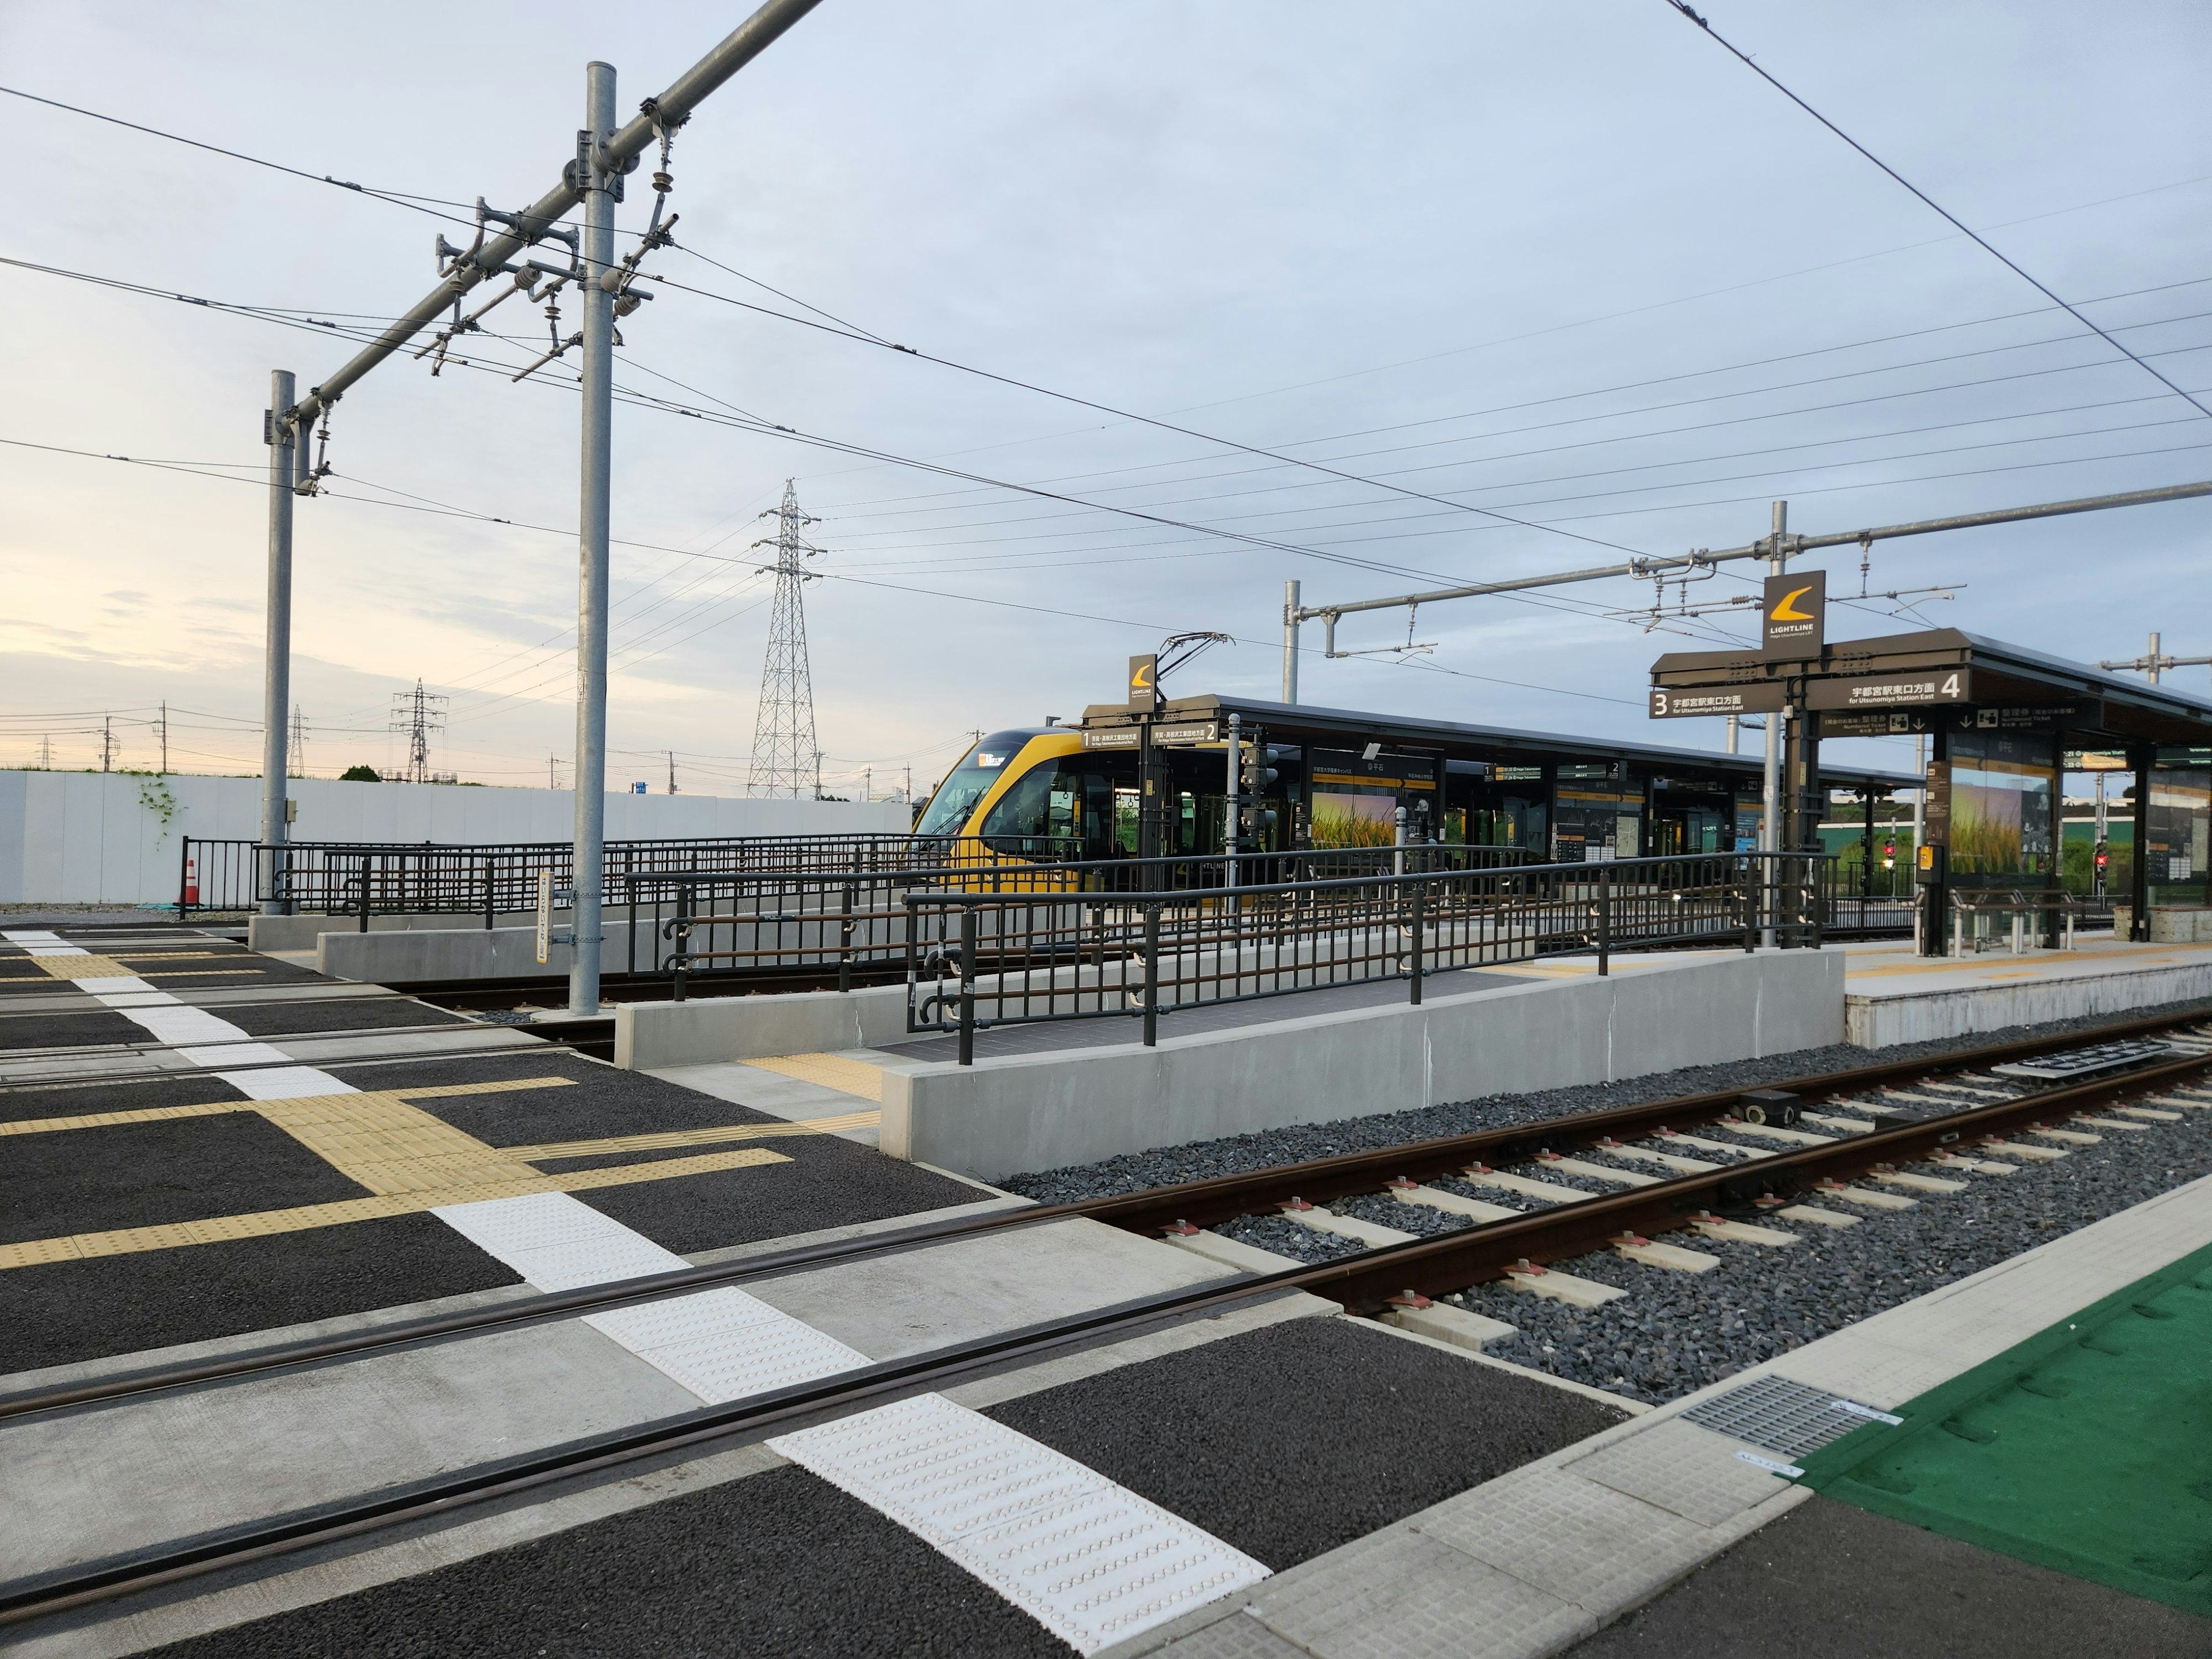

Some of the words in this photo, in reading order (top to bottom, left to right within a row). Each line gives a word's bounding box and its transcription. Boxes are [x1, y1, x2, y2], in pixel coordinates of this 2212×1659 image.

[1770, 623, 1813, 634] LIGHTLINE
[1852, 683, 1935, 698] 宇都宮駅東口方面
[1941, 673, 1960, 698] 4
[1654, 694, 1668, 715] 3
[1673, 695, 1741, 708] 宇都宮駅東口方面
[1859, 695, 1895, 704] Utsunomiya
[1207, 724, 1215, 740] 2
[1084, 732, 1089, 747] 1
[1373, 763, 1384, 771] 平石
[1485, 766, 1489, 775] 1
[1612, 763, 1619, 772] 2
